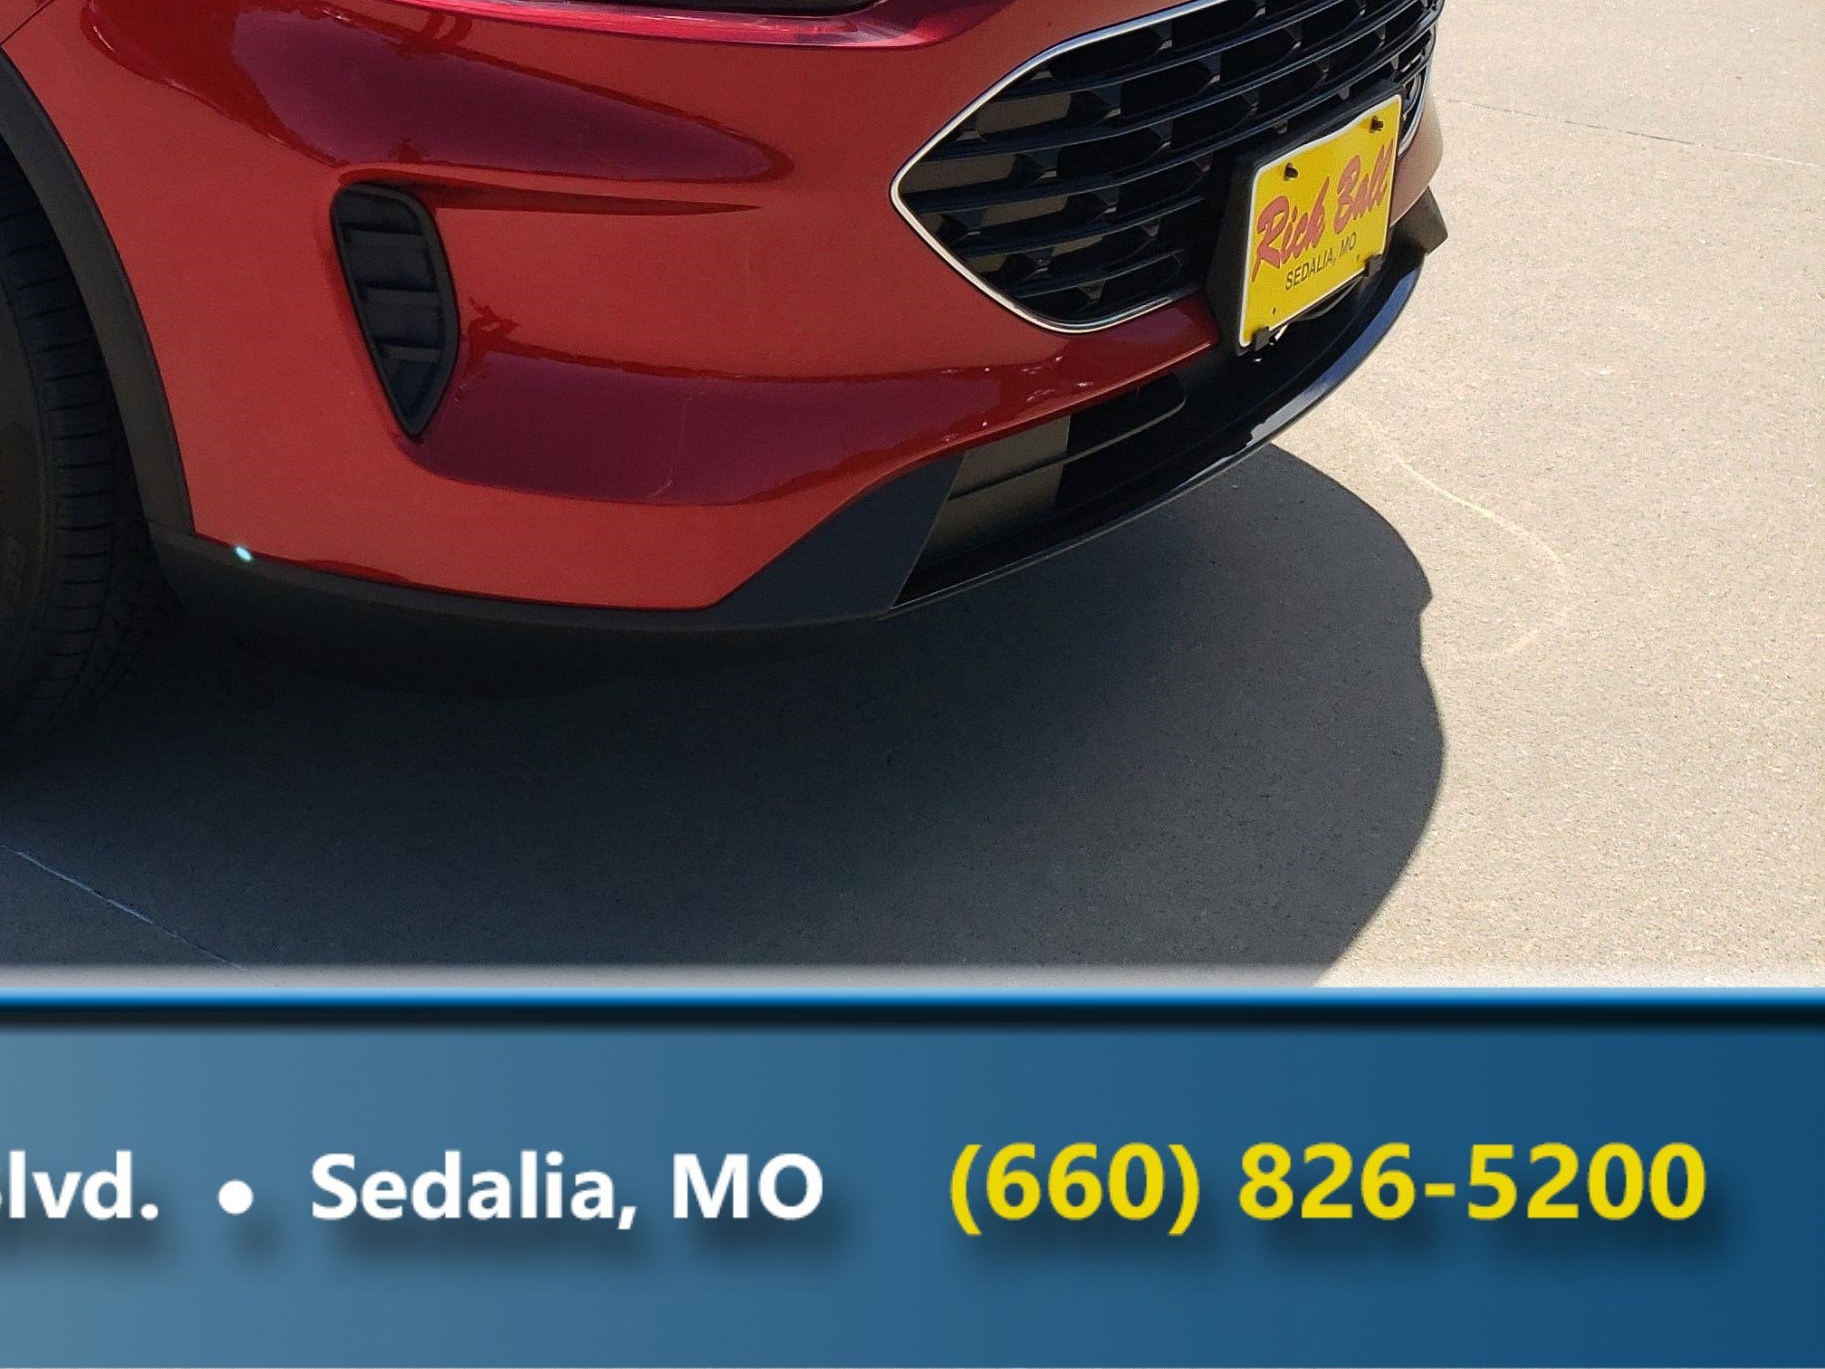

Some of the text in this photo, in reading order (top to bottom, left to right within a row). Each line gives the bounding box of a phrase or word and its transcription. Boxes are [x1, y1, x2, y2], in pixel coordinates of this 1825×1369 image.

[1251, 138, 1395, 282] Rick Ball
[1285, 231, 1357, 291] SEDALIA, MO
